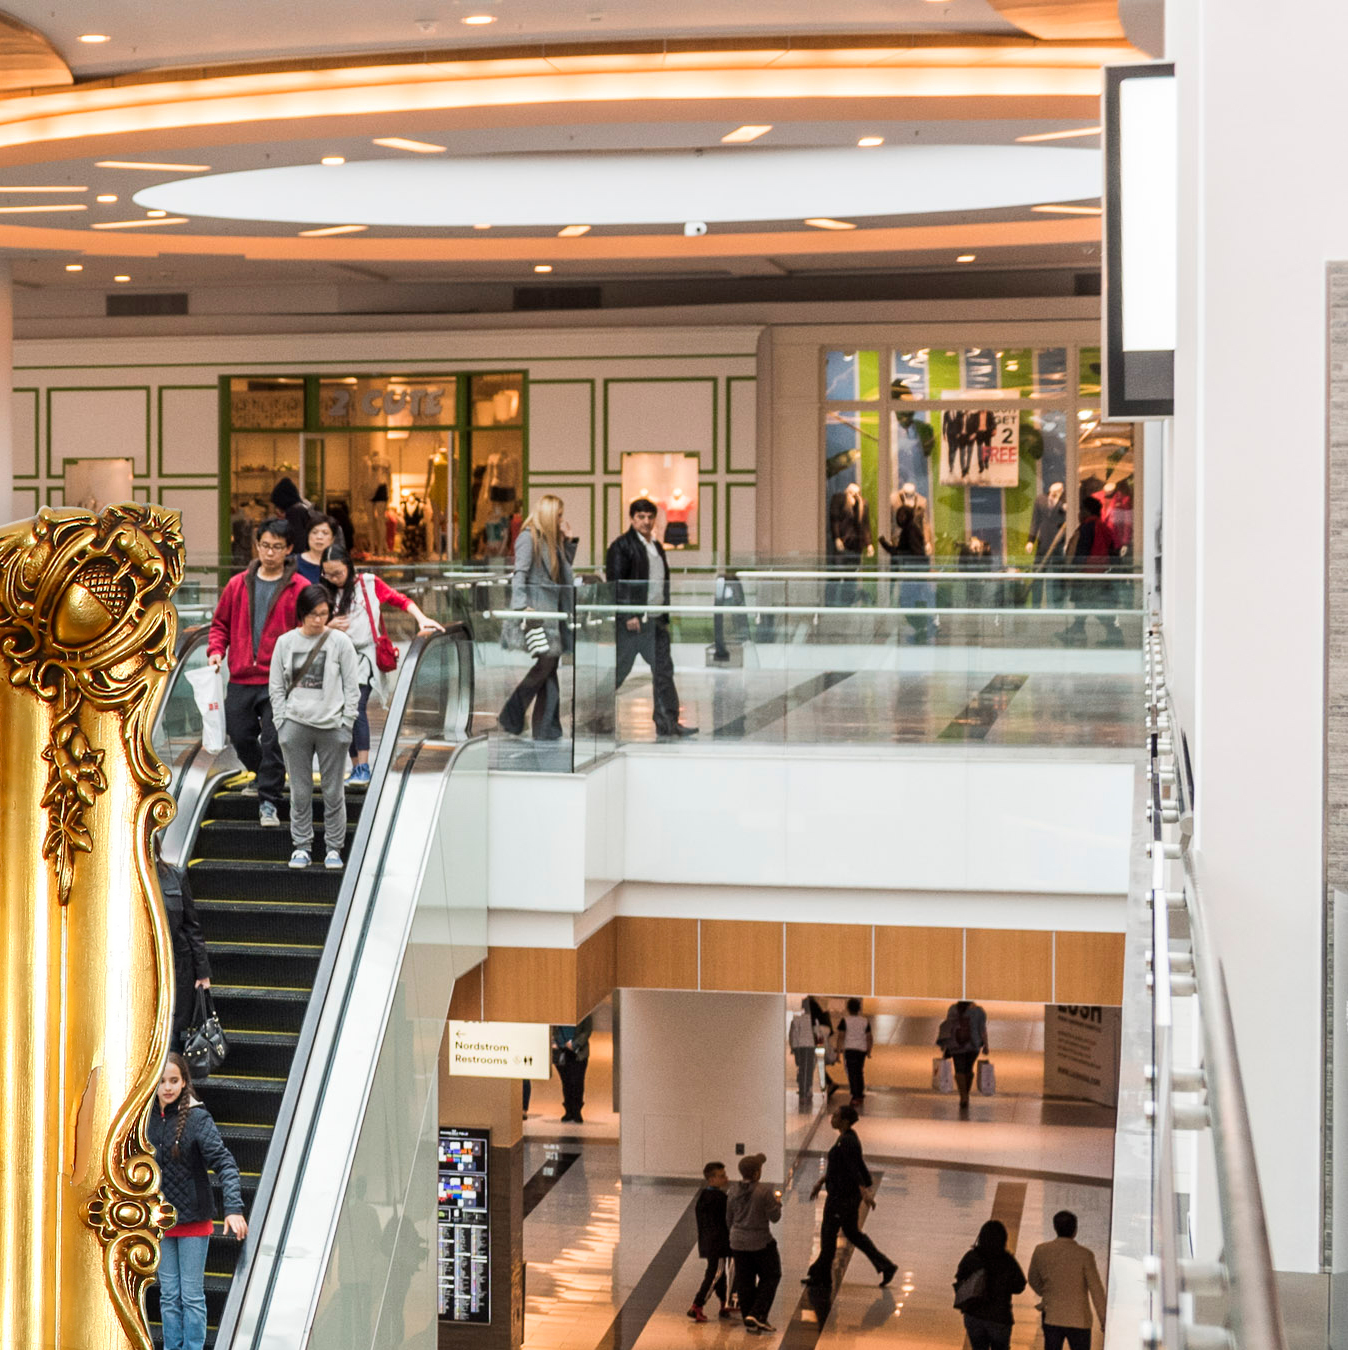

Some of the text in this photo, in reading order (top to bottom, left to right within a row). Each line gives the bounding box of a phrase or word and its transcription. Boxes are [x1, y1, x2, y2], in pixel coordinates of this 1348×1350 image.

[329, 389, 445, 416] 2 CUTE
[1002, 428, 1014, 444] 2
[982, 446, 1017, 464] FREE
[455, 1041, 509, 1052] Nordstrom
[455, 1054, 508, 1065] Restrooms
